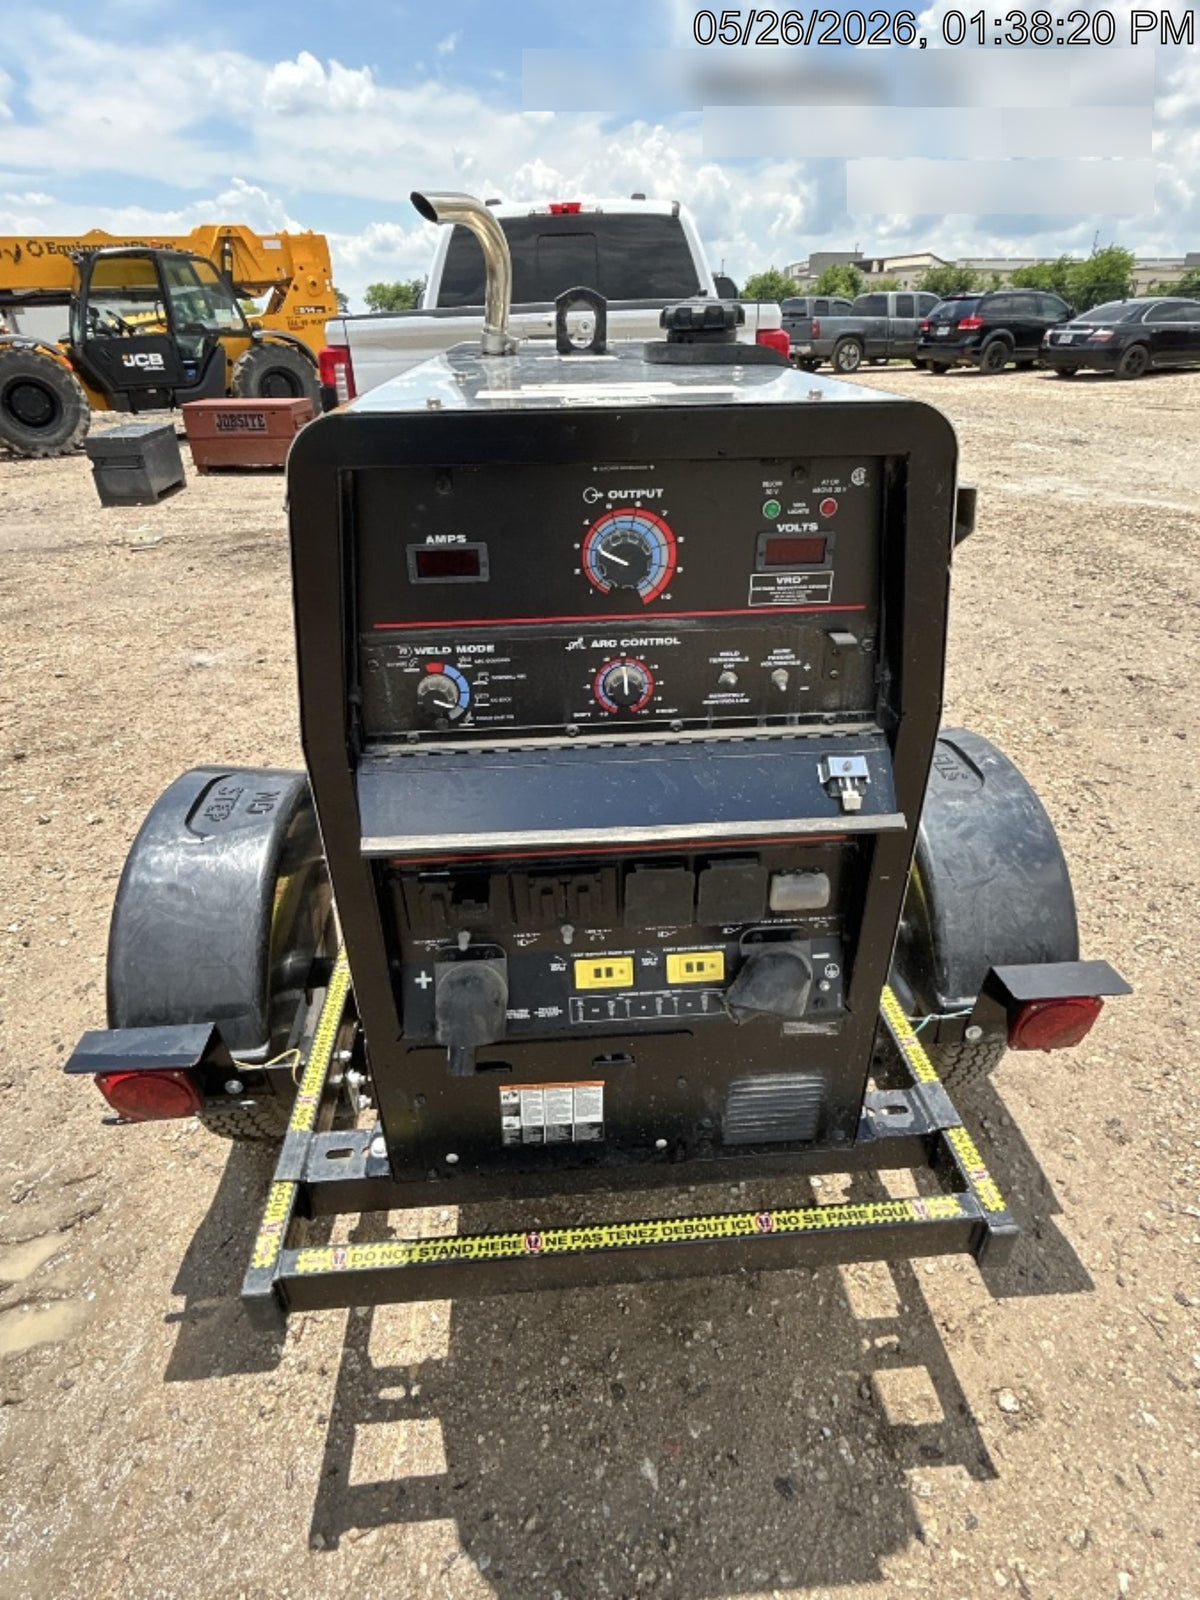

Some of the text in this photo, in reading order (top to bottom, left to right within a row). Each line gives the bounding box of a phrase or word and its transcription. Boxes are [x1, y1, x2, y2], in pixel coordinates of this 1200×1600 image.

[122, 353, 164, 367] JCB
[216, 413, 266, 428] JOBSITE
[608, 488, 664, 499] OUTPUT
[776, 522, 819, 533] VOLTS
[426, 534, 467, 545] AMPS
[415, 644, 496, 655] WELD MODE
[591, 637, 682, 649] ARC CONTROL
[776, 1214, 799, 1228] NO
[803, 1212, 824, 1225] SE
[827, 1208, 869, 1223] PARE
[545, 1220, 752, 1248] NE PAS TENEZ DEBOUT ICI
[351, 1238, 522, 1263] DO NOT STAND HERE
